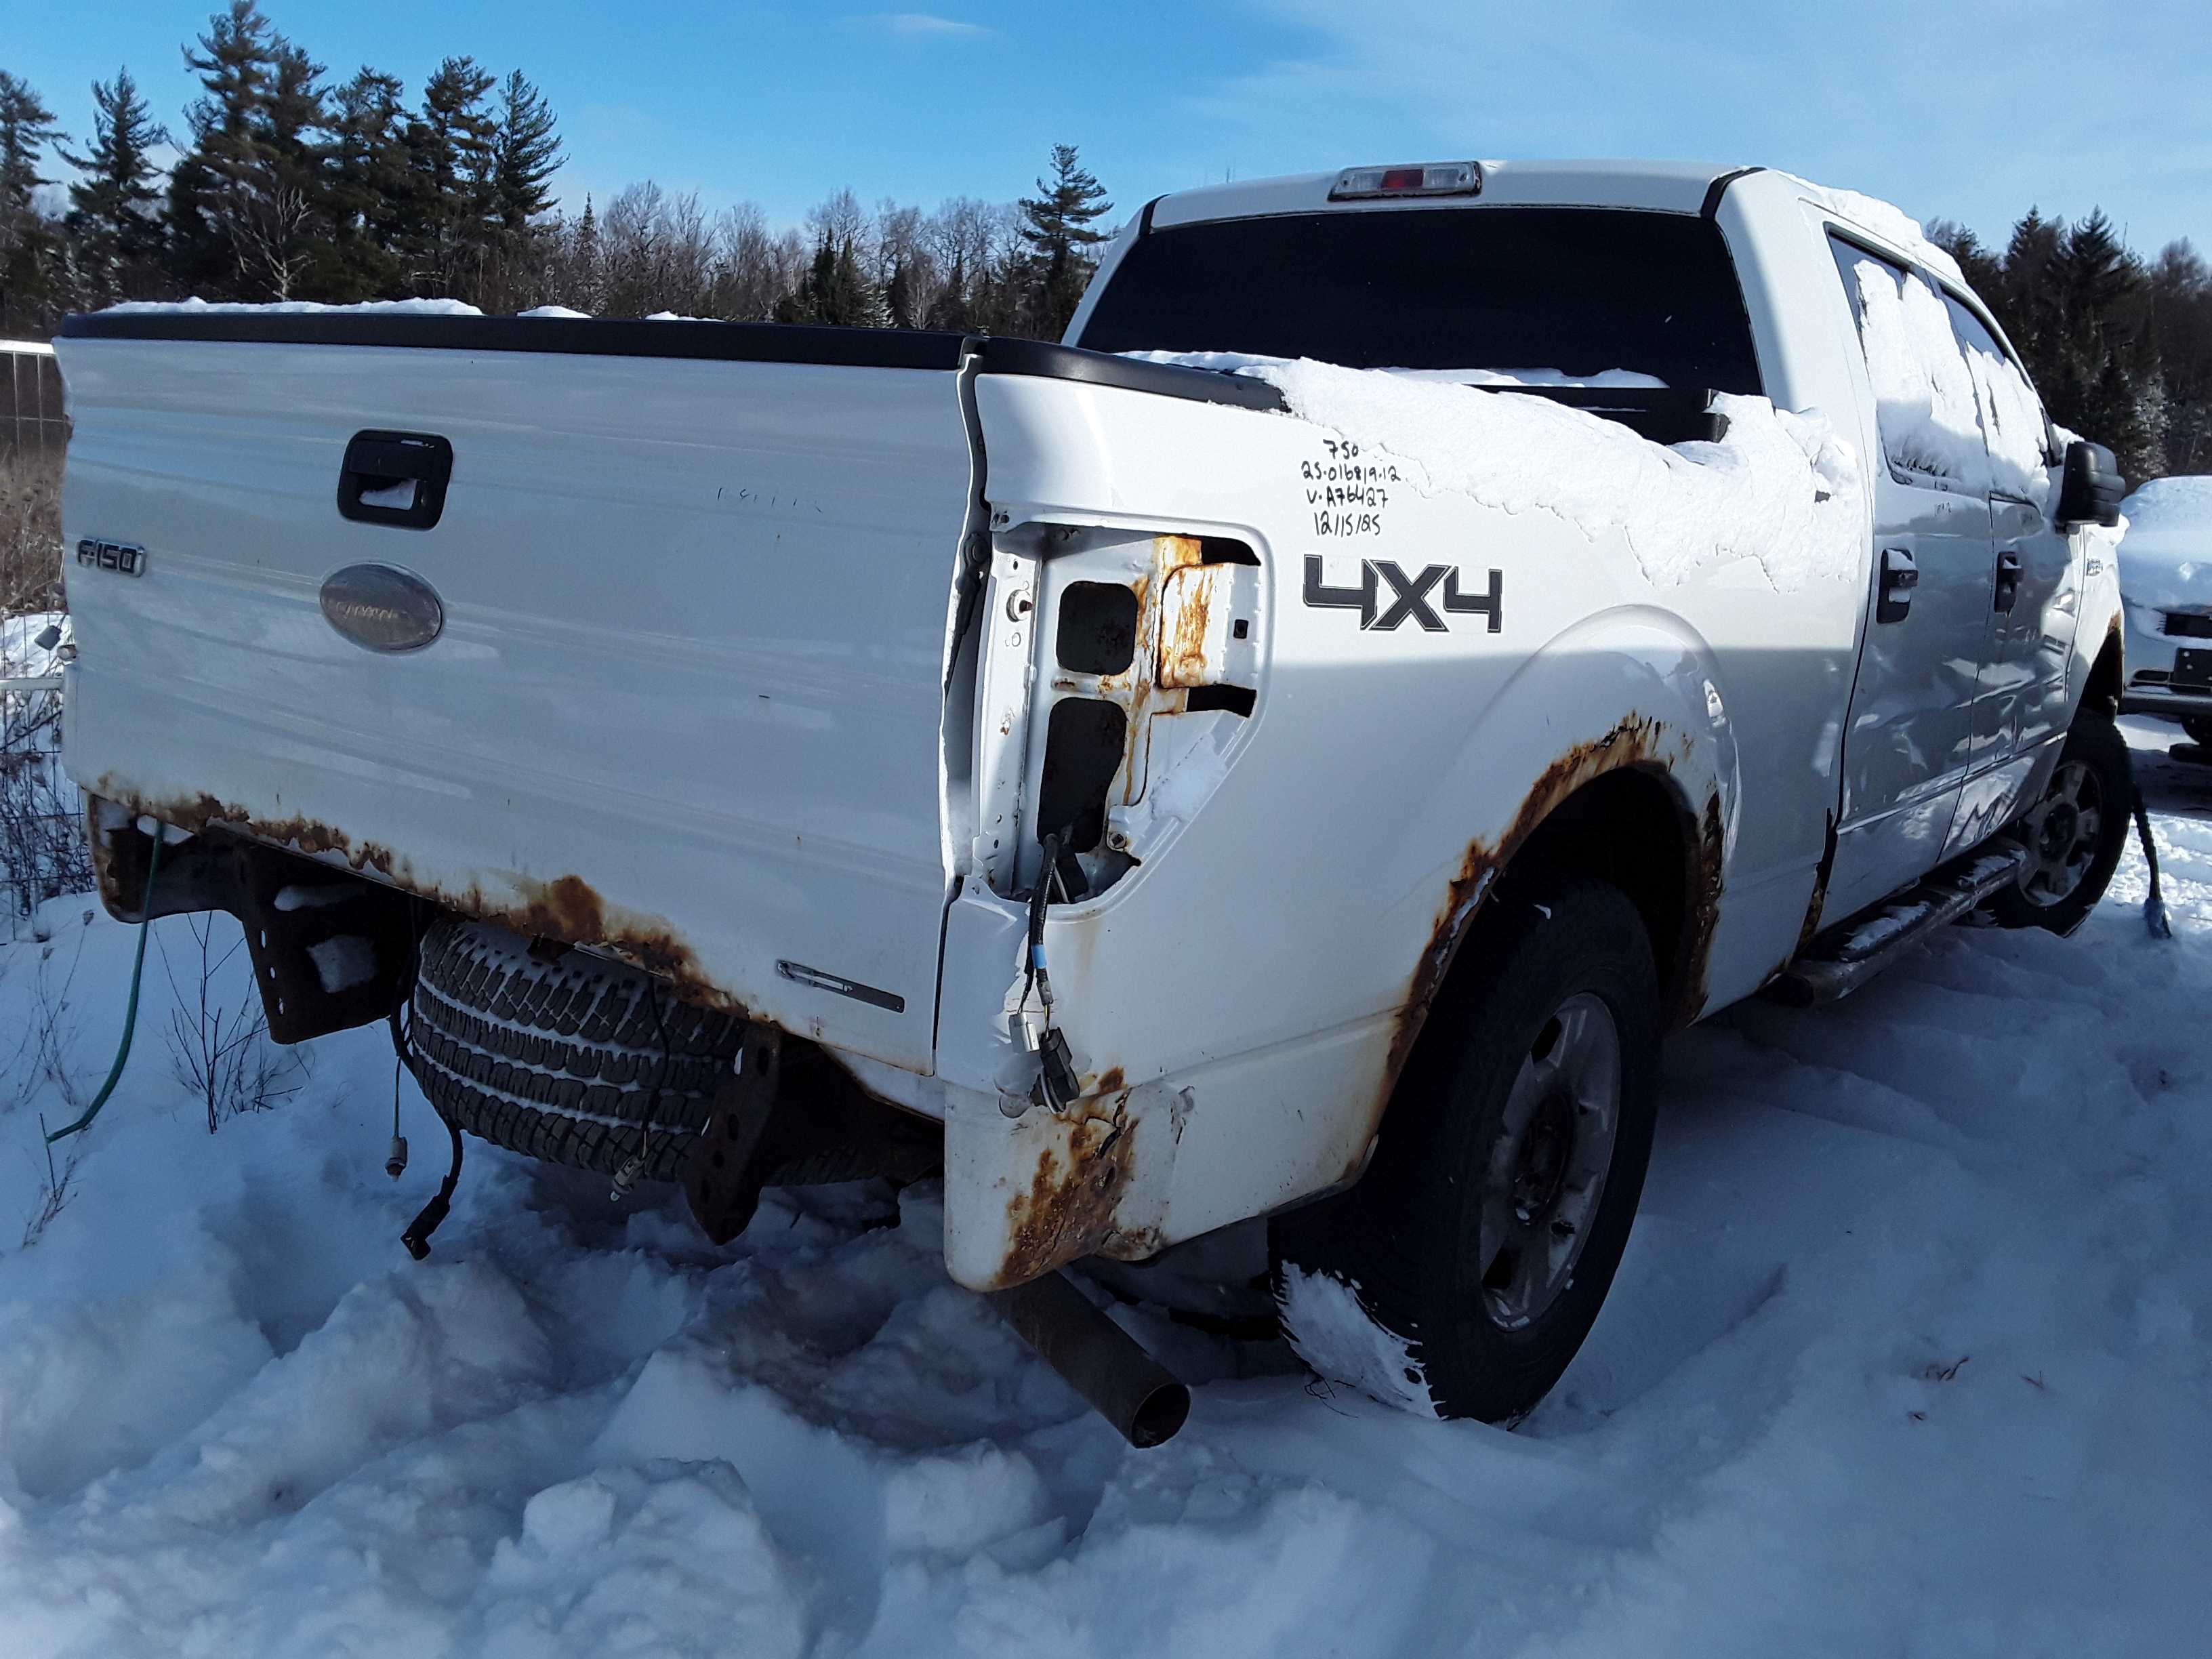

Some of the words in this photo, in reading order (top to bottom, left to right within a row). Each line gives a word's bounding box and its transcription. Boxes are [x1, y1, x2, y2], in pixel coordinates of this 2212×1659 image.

[1323, 439, 1359, 459] 750
[1314, 510, 1380, 537] 12/15/25
[1303, 554, 1502, 634] 4X4
